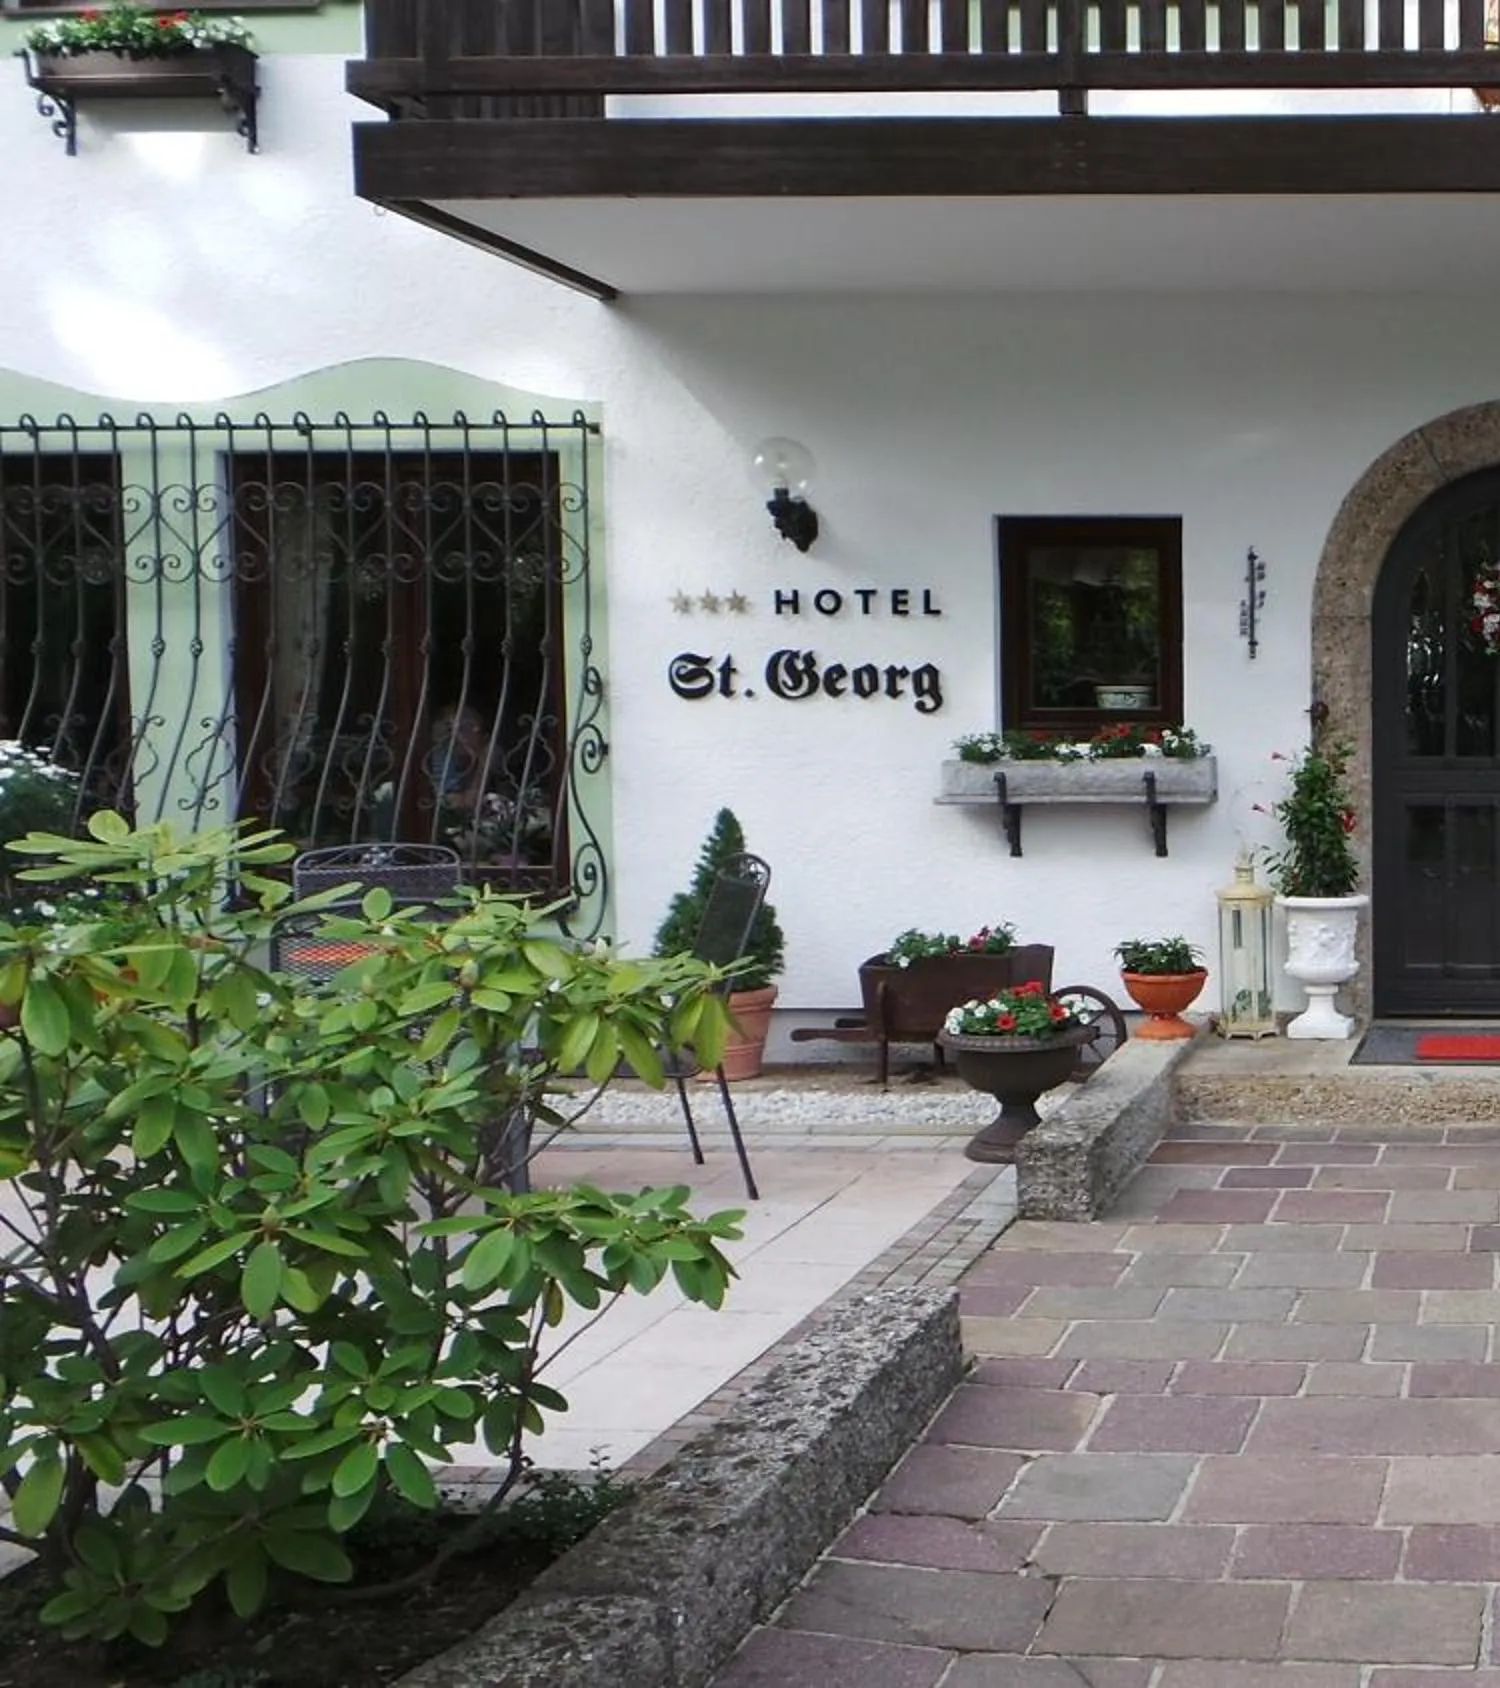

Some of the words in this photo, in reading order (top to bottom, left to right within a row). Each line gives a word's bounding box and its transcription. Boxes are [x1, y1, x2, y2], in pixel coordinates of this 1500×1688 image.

[774, 588, 942, 615] HOTEL
[668, 652, 754, 700] St.
[765, 649, 943, 714] Georg
